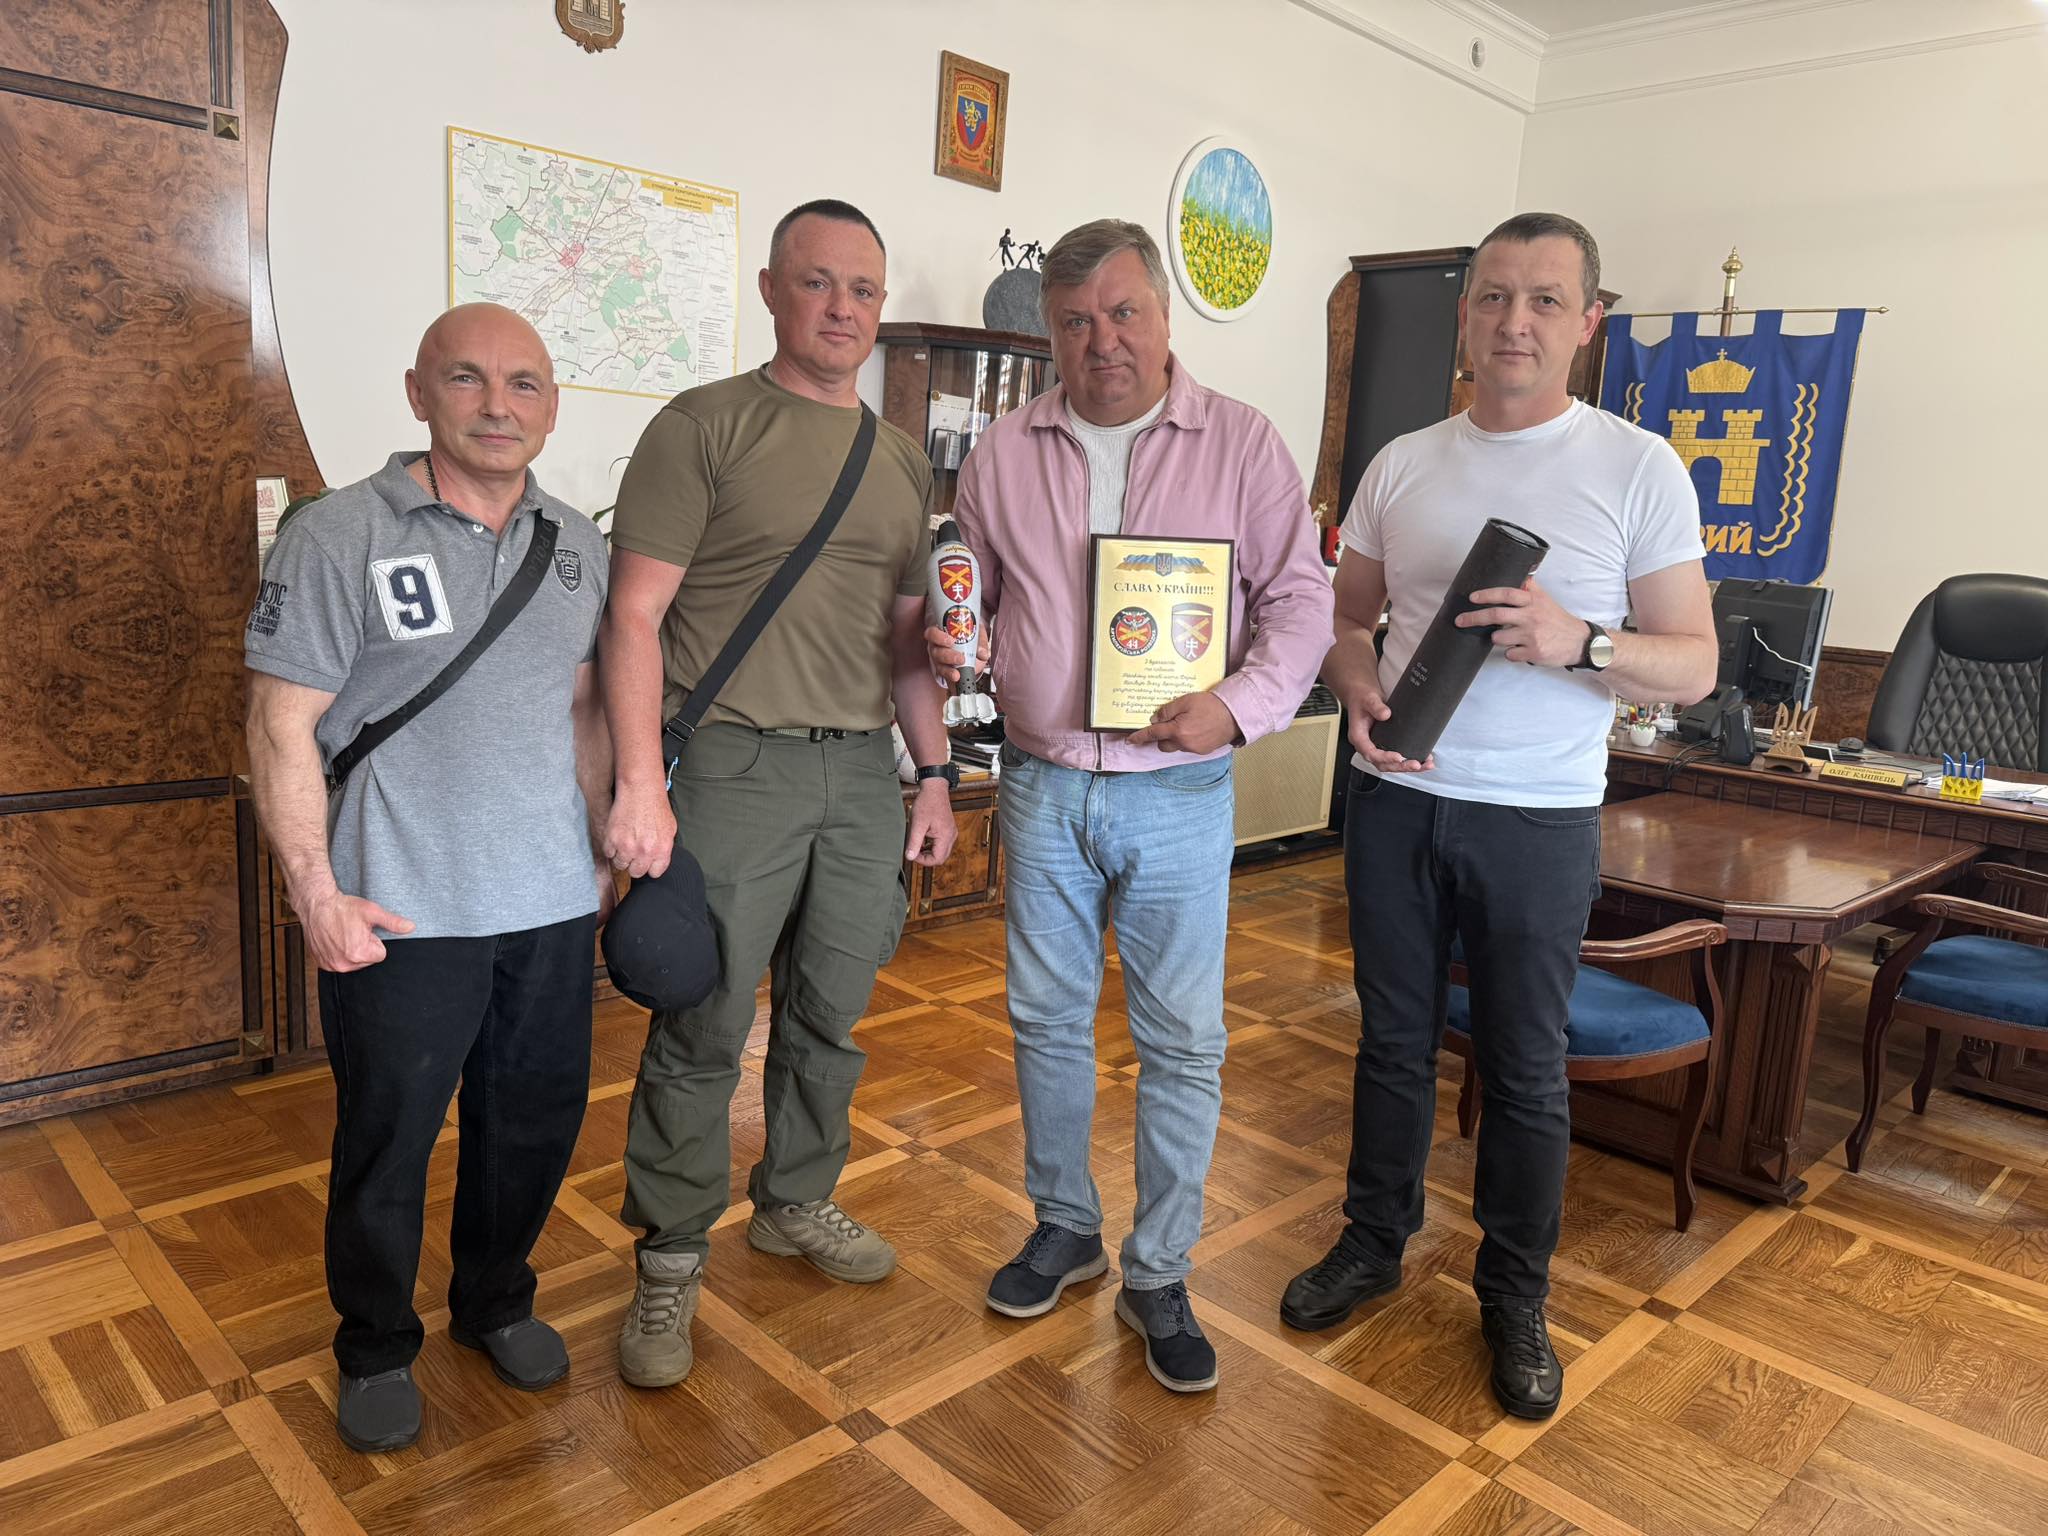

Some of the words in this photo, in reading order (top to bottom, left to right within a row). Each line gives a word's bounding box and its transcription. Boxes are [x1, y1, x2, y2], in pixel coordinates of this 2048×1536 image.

[1113, 582, 1152, 594] СЛАВА
[388, 565, 437, 631] 9
[1828, 768, 1850, 777] ОЛЕГ
